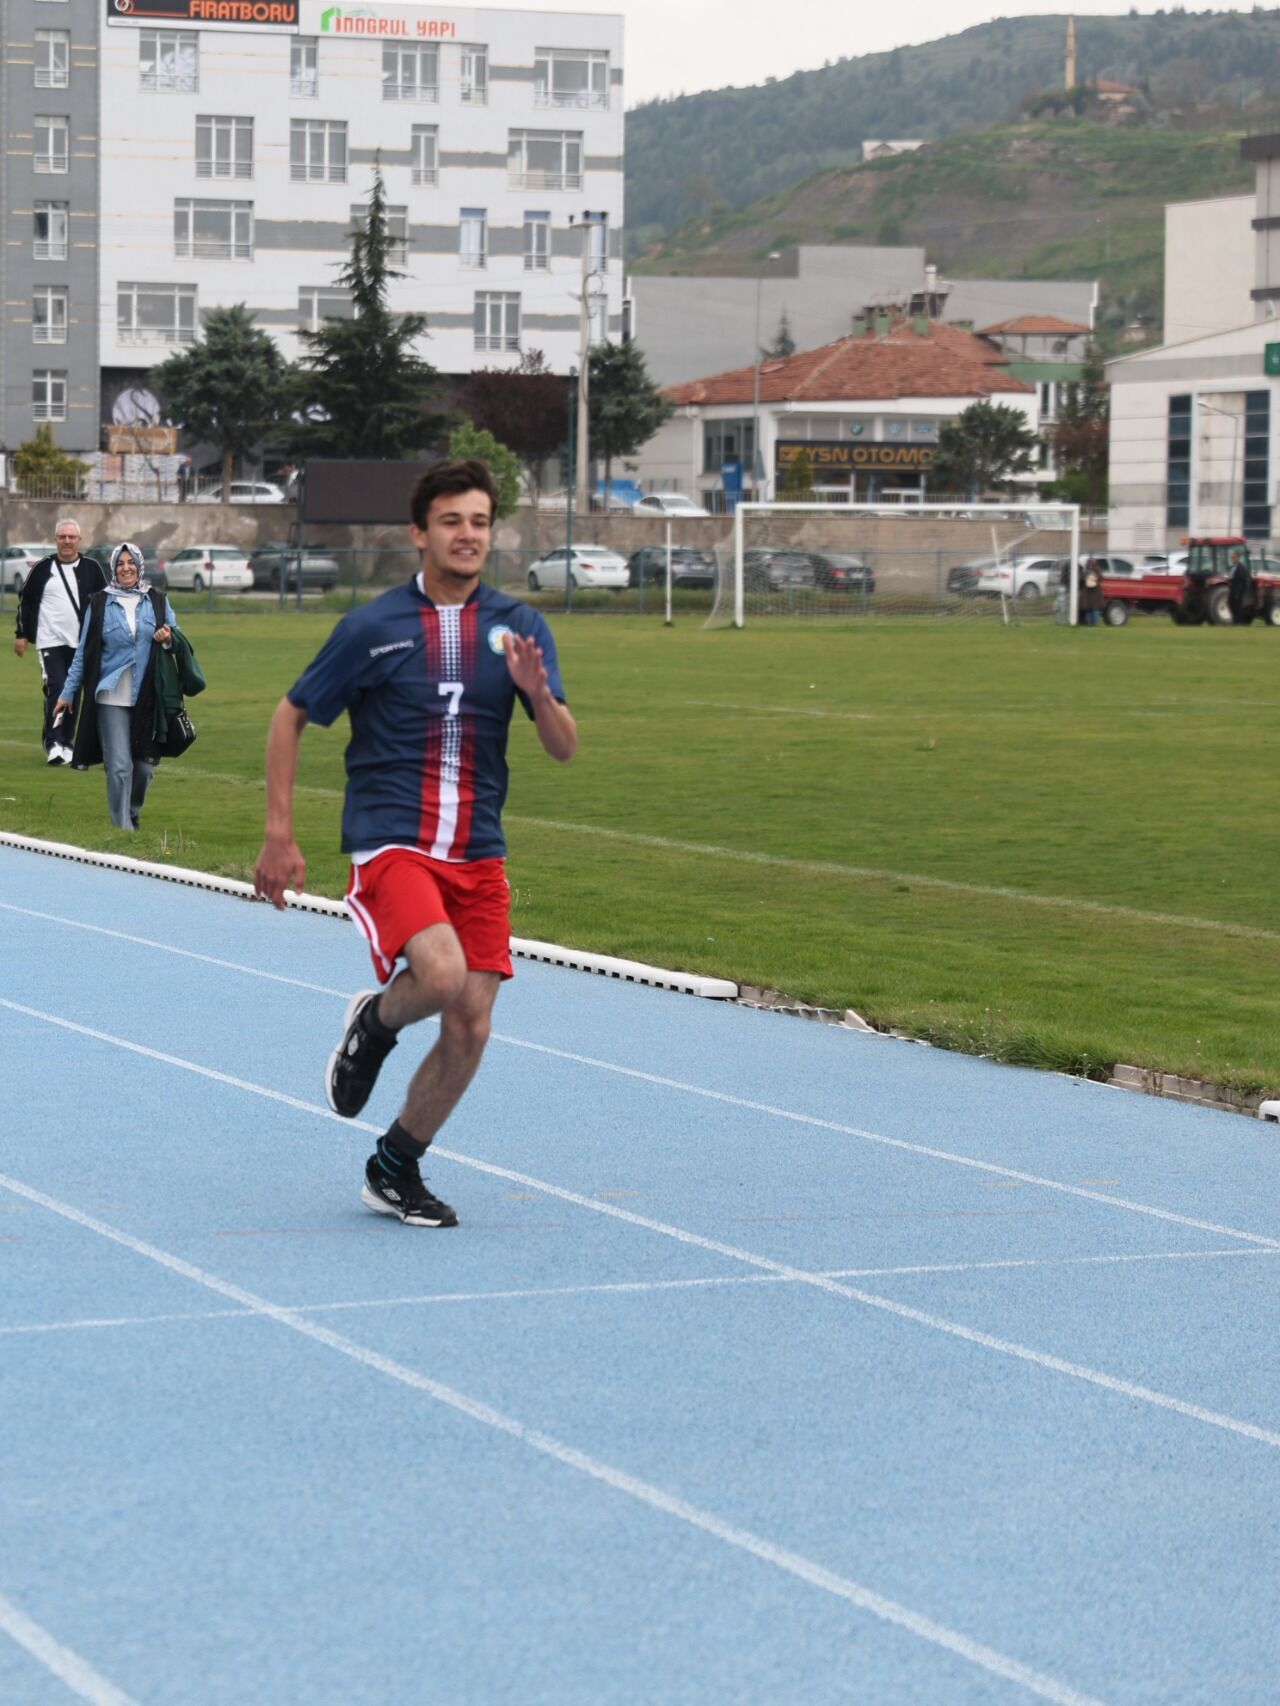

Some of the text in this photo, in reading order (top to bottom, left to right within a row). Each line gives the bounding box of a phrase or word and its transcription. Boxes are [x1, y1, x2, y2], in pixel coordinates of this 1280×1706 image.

[189, 0, 295, 22] FIRATBORU
[417, 20, 456, 38] YAPI
[438, 682, 464, 715] 7
